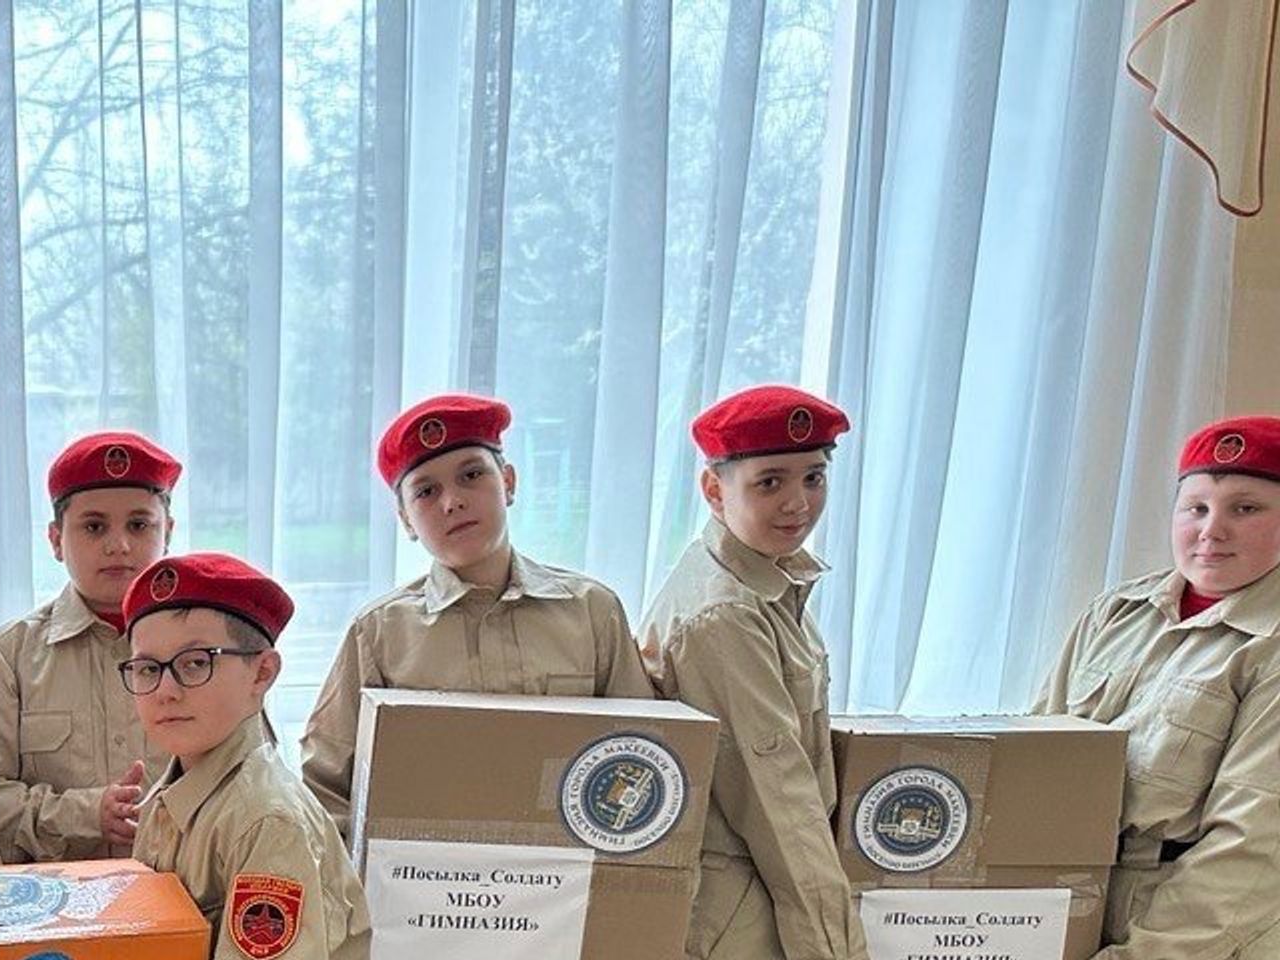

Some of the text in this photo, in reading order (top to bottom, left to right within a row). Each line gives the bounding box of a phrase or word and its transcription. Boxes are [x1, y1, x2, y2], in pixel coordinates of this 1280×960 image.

[898, 775, 943, 790] ГОРОДА
[570, 742, 669, 845] ГИМНАЗИЯ ГОРОДА МАКЕЕВКИ
[392, 865, 564, 889] #Посылка_Солдату
[446, 892, 505, 908] МБОУ
[407, 914, 540, 932] «ГИМНАЗИЯ»
[883, 911, 1044, 929] #Посылка_Солдату
[933, 934, 989, 948] МБОУ
